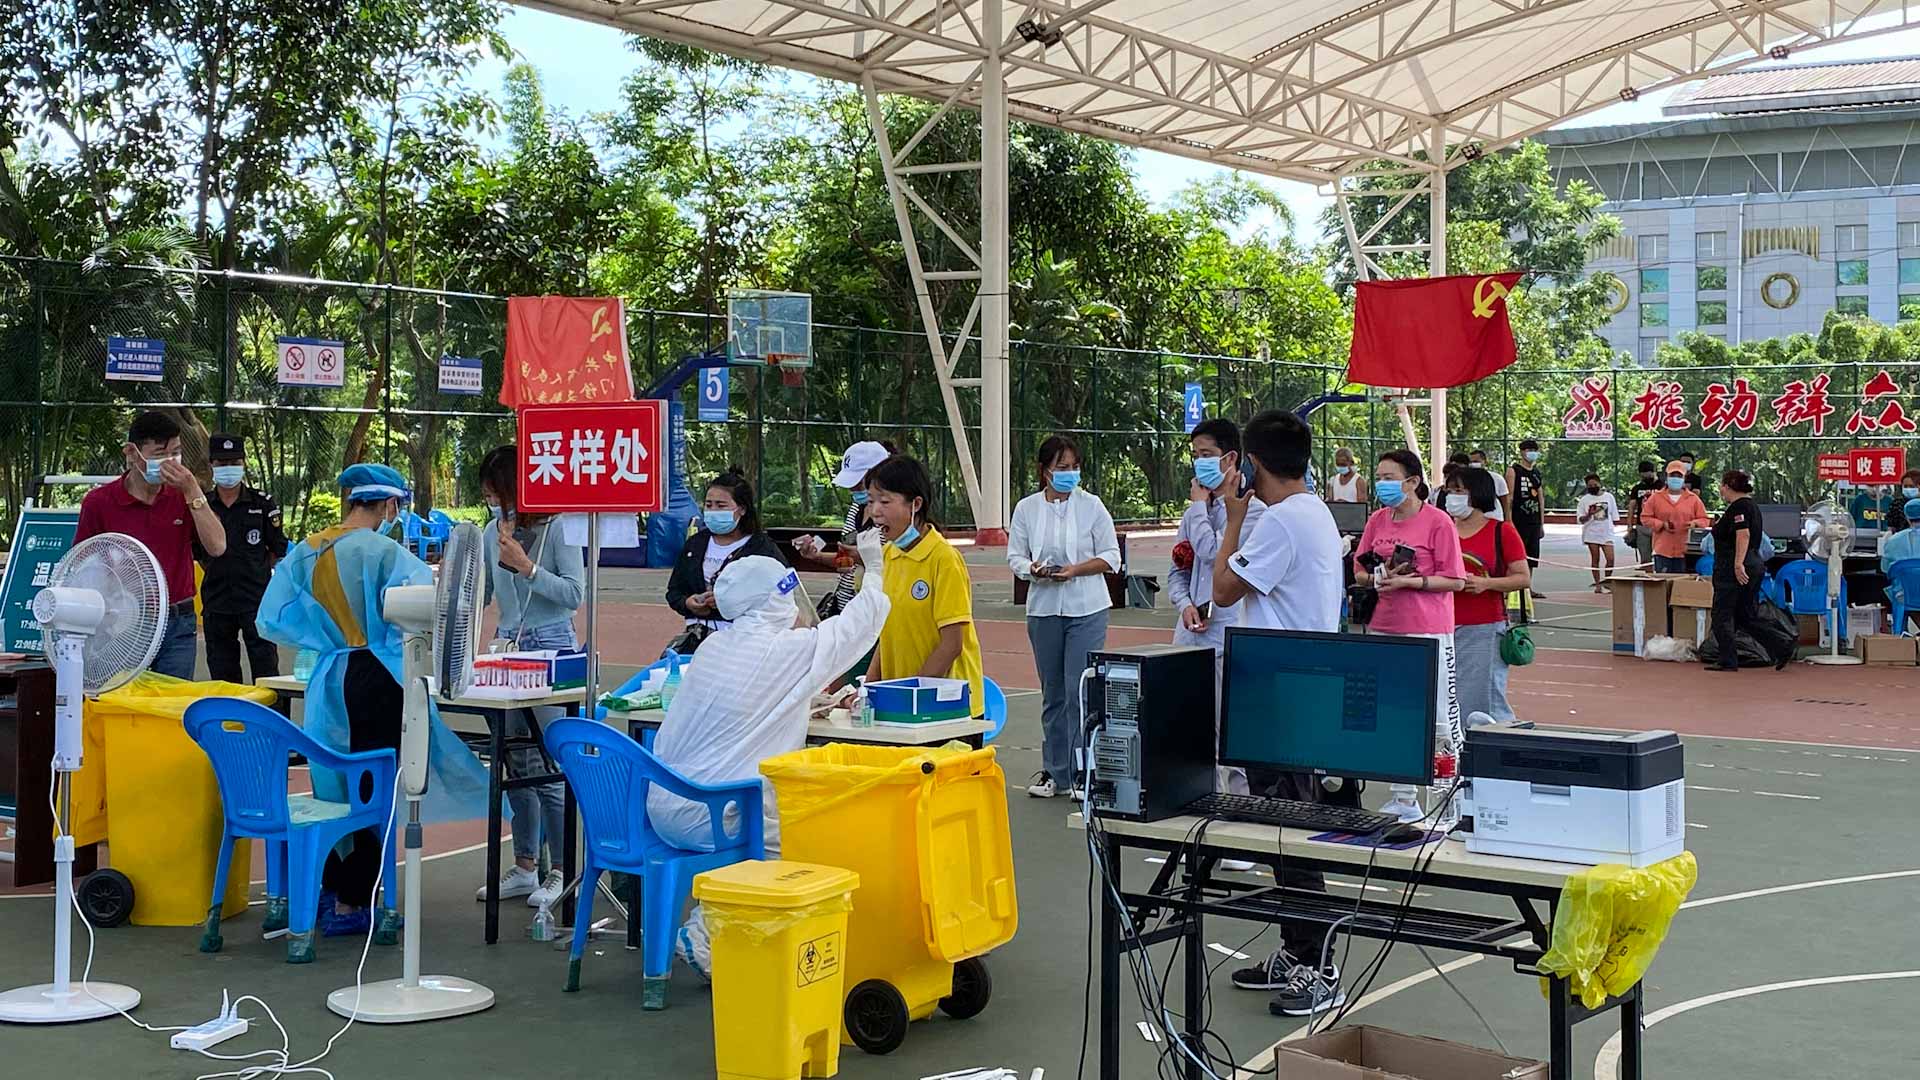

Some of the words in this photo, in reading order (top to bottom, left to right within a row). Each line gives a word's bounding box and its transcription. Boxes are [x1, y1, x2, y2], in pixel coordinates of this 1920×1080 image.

[706, 367, 722, 402] 5
[1188, 392, 1200, 419] 4
[1629, 370, 1916, 435] 推动群众
[528, 428, 649, 486] 采样处
[1856, 457, 1897, 476] 收费
[31, 562, 56, 587] 温
